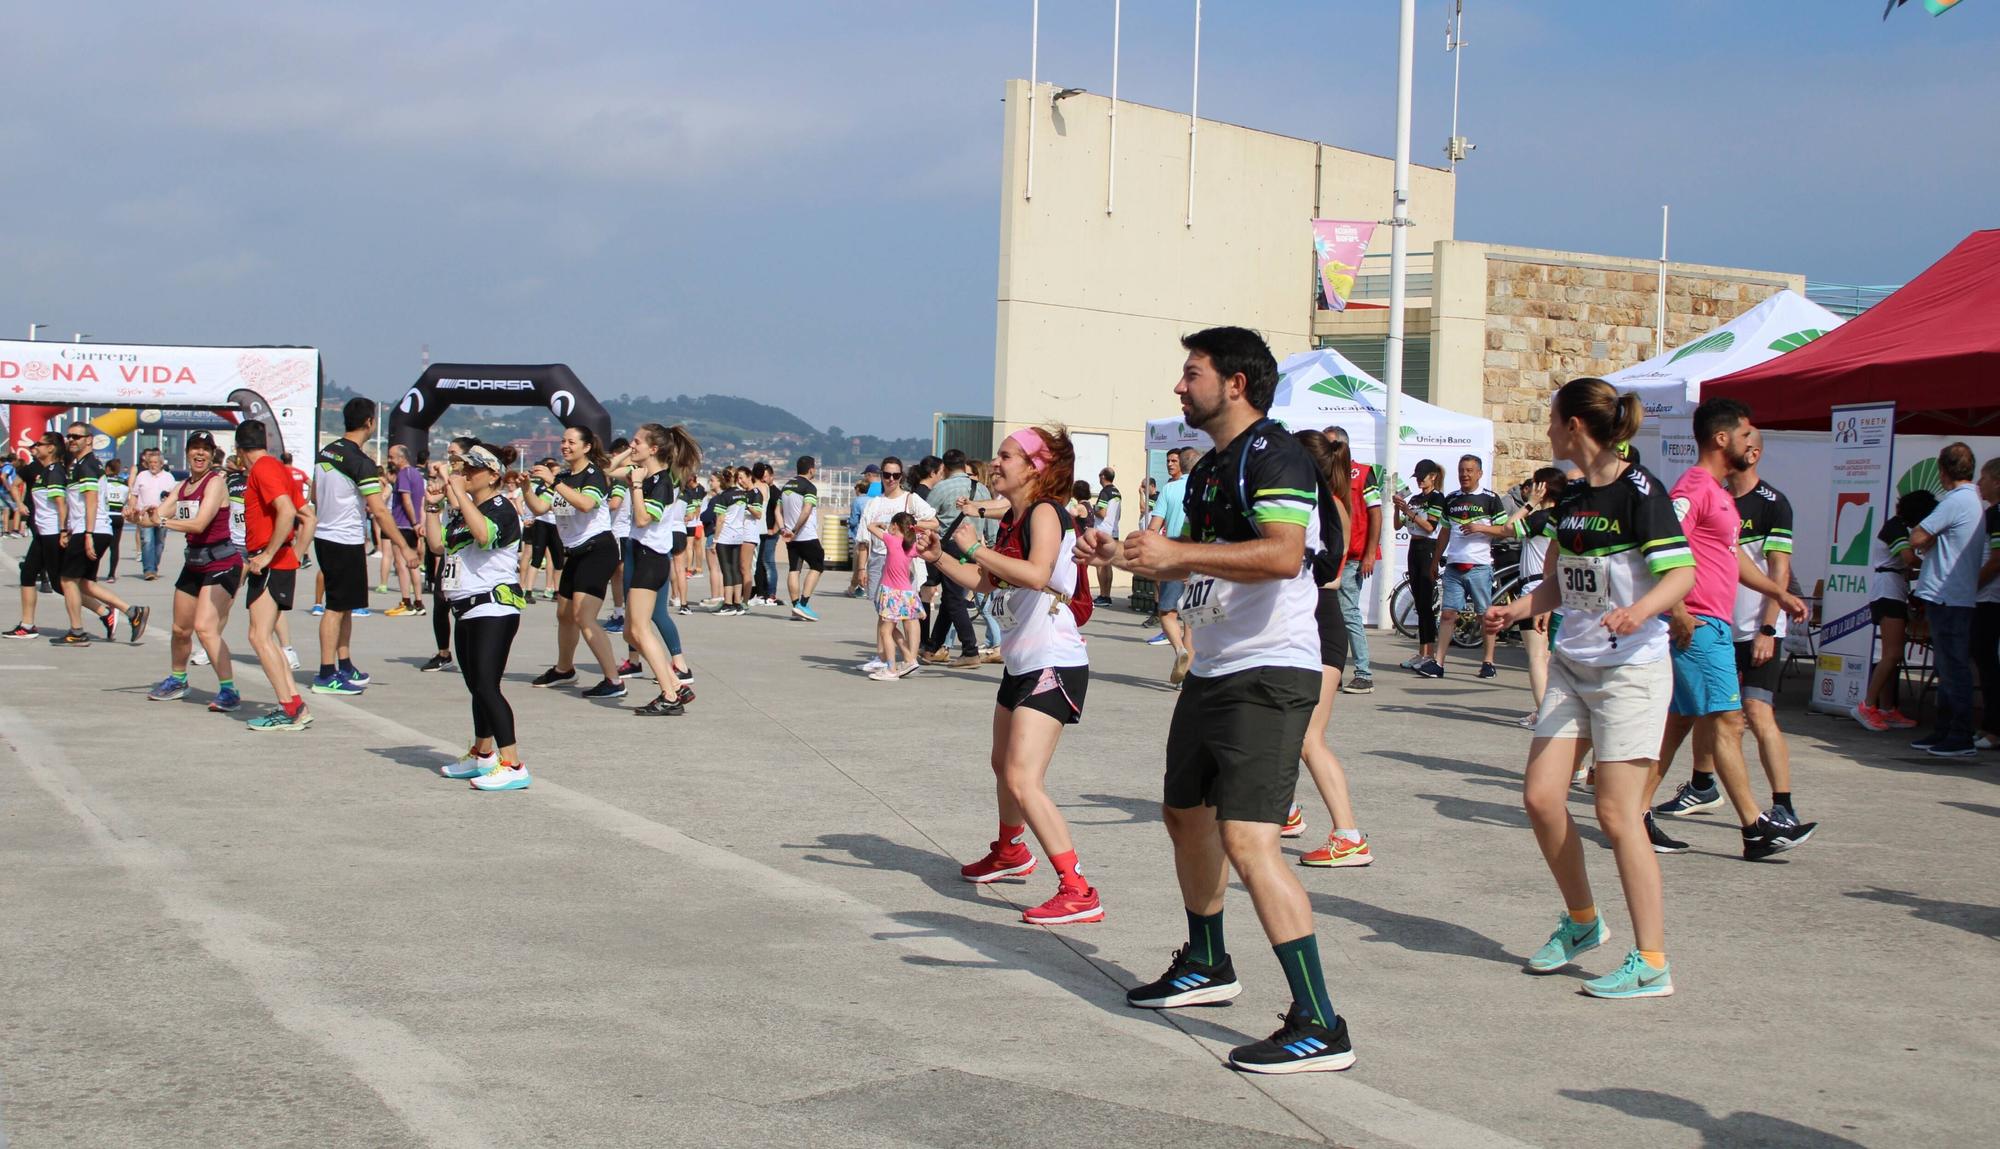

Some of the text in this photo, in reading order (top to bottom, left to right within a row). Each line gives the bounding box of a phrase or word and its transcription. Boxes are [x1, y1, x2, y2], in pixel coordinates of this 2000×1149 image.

[61, 349, 138, 361] Carrera
[119, 365, 197, 384] VIDA
[456, 379, 535, 390] ADARSA
[1318, 404, 1365, 412] Unicaja
[1416, 436, 1447, 445] Unicaja
[180, 507, 190, 519] 90
[1564, 567, 1597, 593] 303
[1827, 574, 1867, 593] ATHA
[1182, 579, 1215, 610] 207
